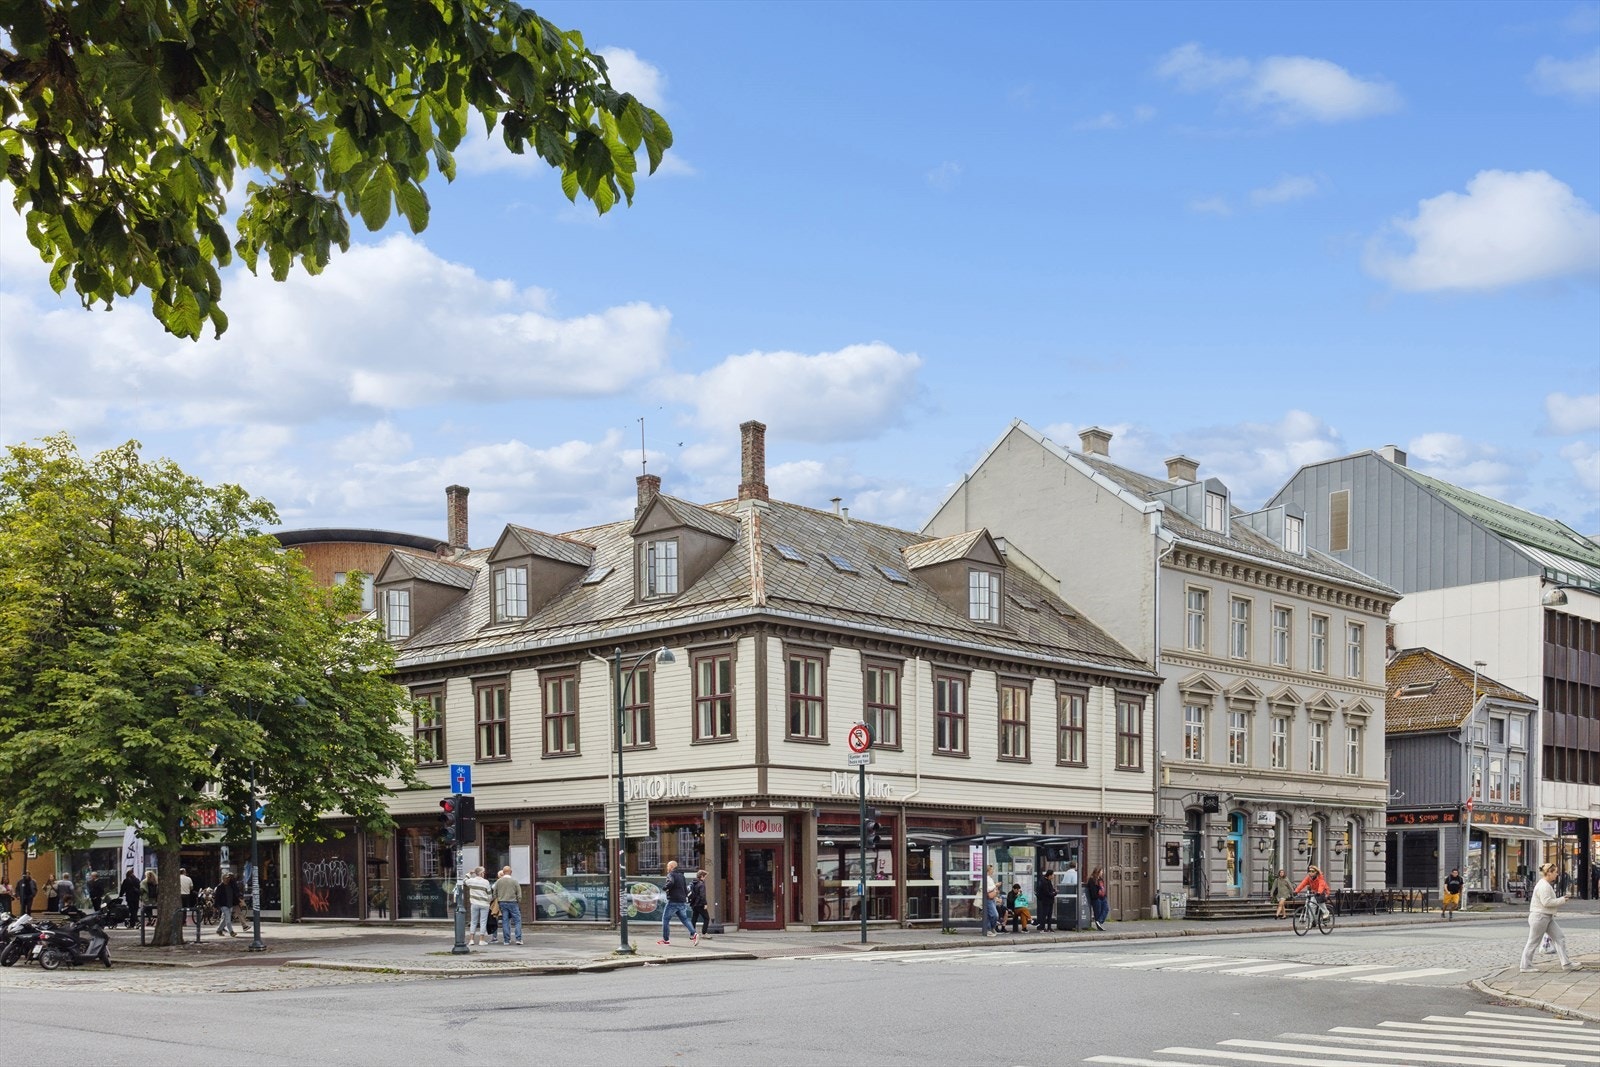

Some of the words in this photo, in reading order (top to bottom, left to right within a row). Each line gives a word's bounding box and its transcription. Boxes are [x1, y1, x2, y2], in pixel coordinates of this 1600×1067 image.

[627, 775, 646, 800] Deli
[648, 775, 664, 799] de
[666, 773, 690, 797] Luca
[831, 771, 851, 796] Deli
[741, 819, 754, 833] Deli
[755, 820, 767, 833] de
[767, 819, 782, 833] Luca
